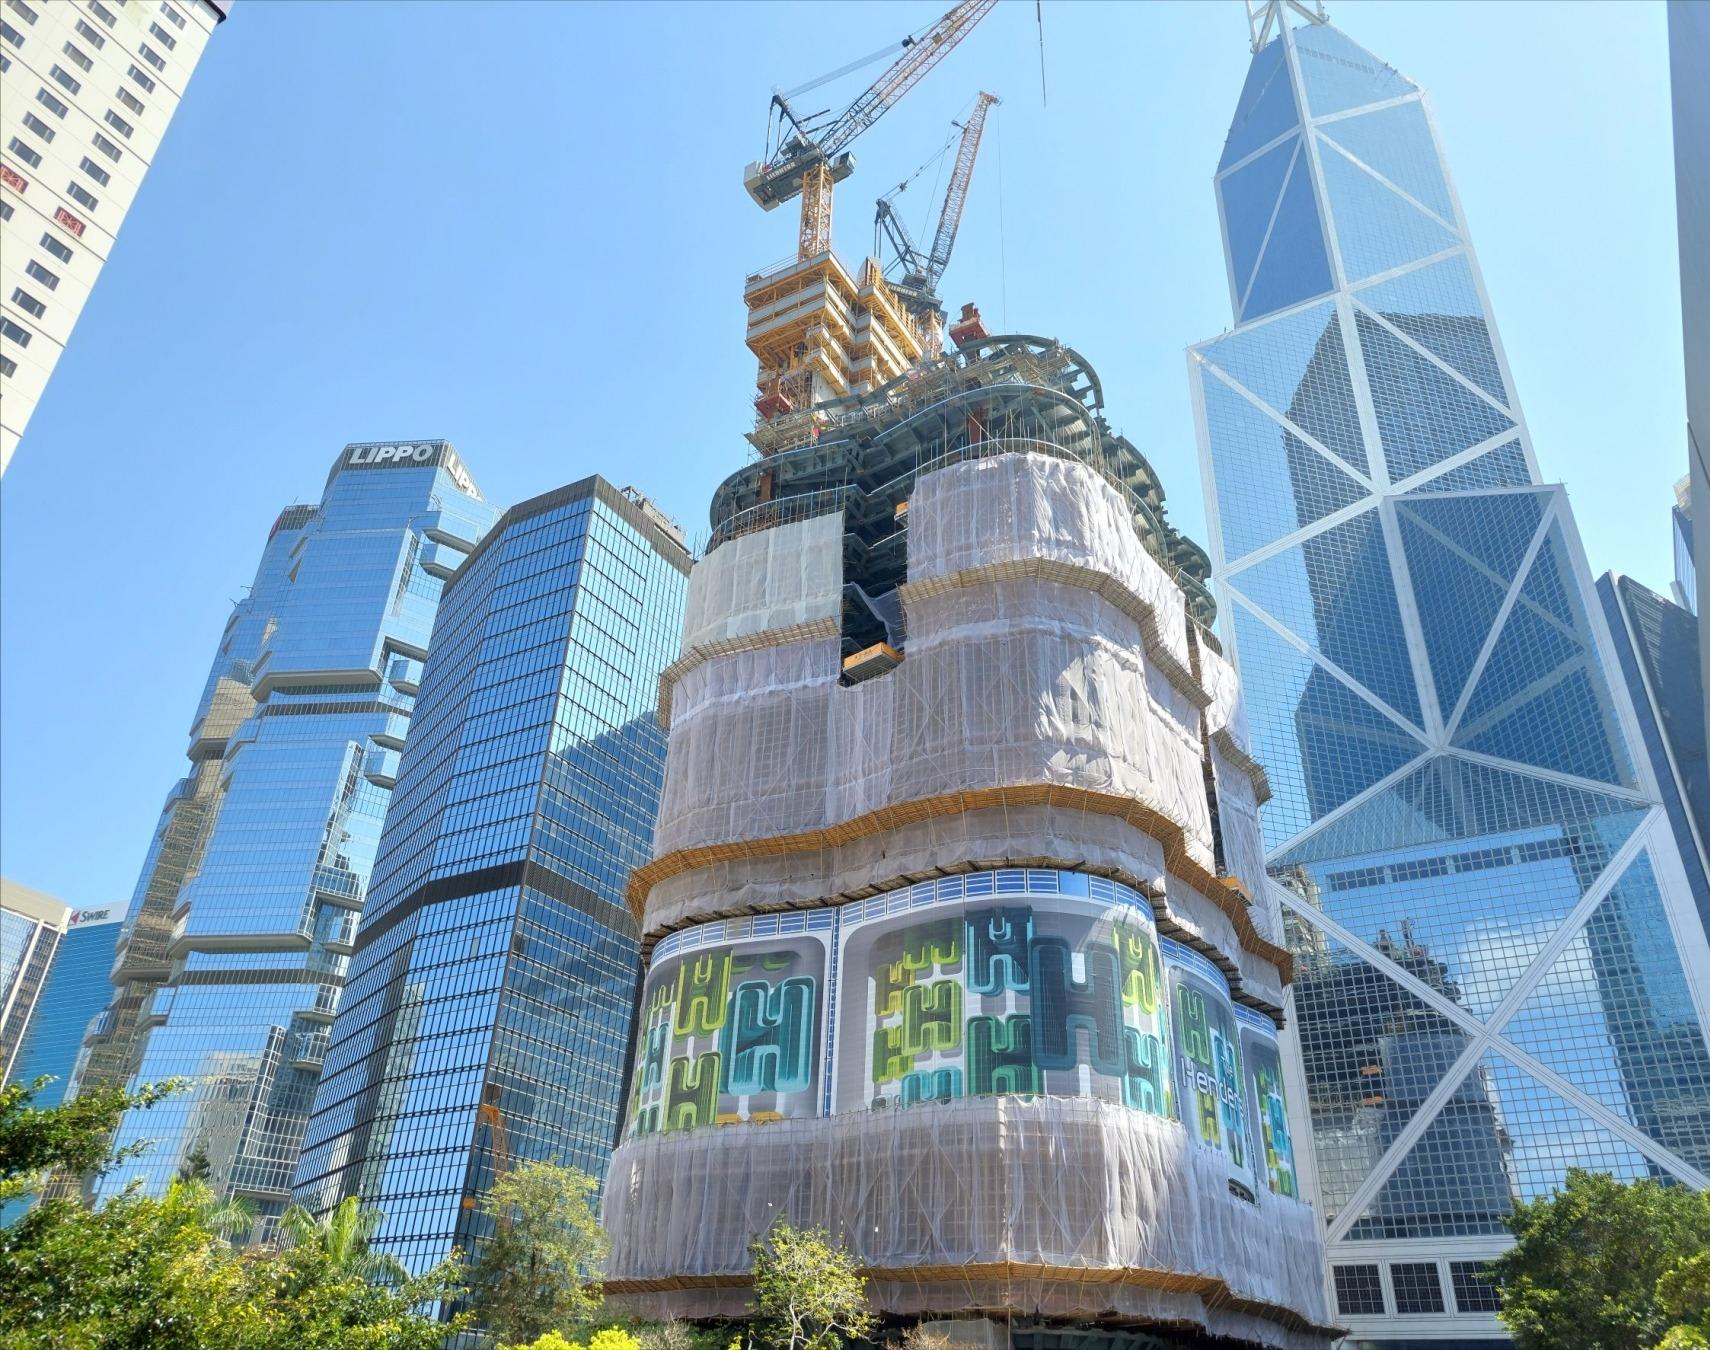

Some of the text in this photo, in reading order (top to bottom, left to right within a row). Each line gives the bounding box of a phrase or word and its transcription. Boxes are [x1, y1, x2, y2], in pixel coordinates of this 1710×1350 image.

[350, 444, 433, 464] LIPPO
[80, 909, 110, 922] SWIRE
[1181, 1056, 1247, 1121] Henders
